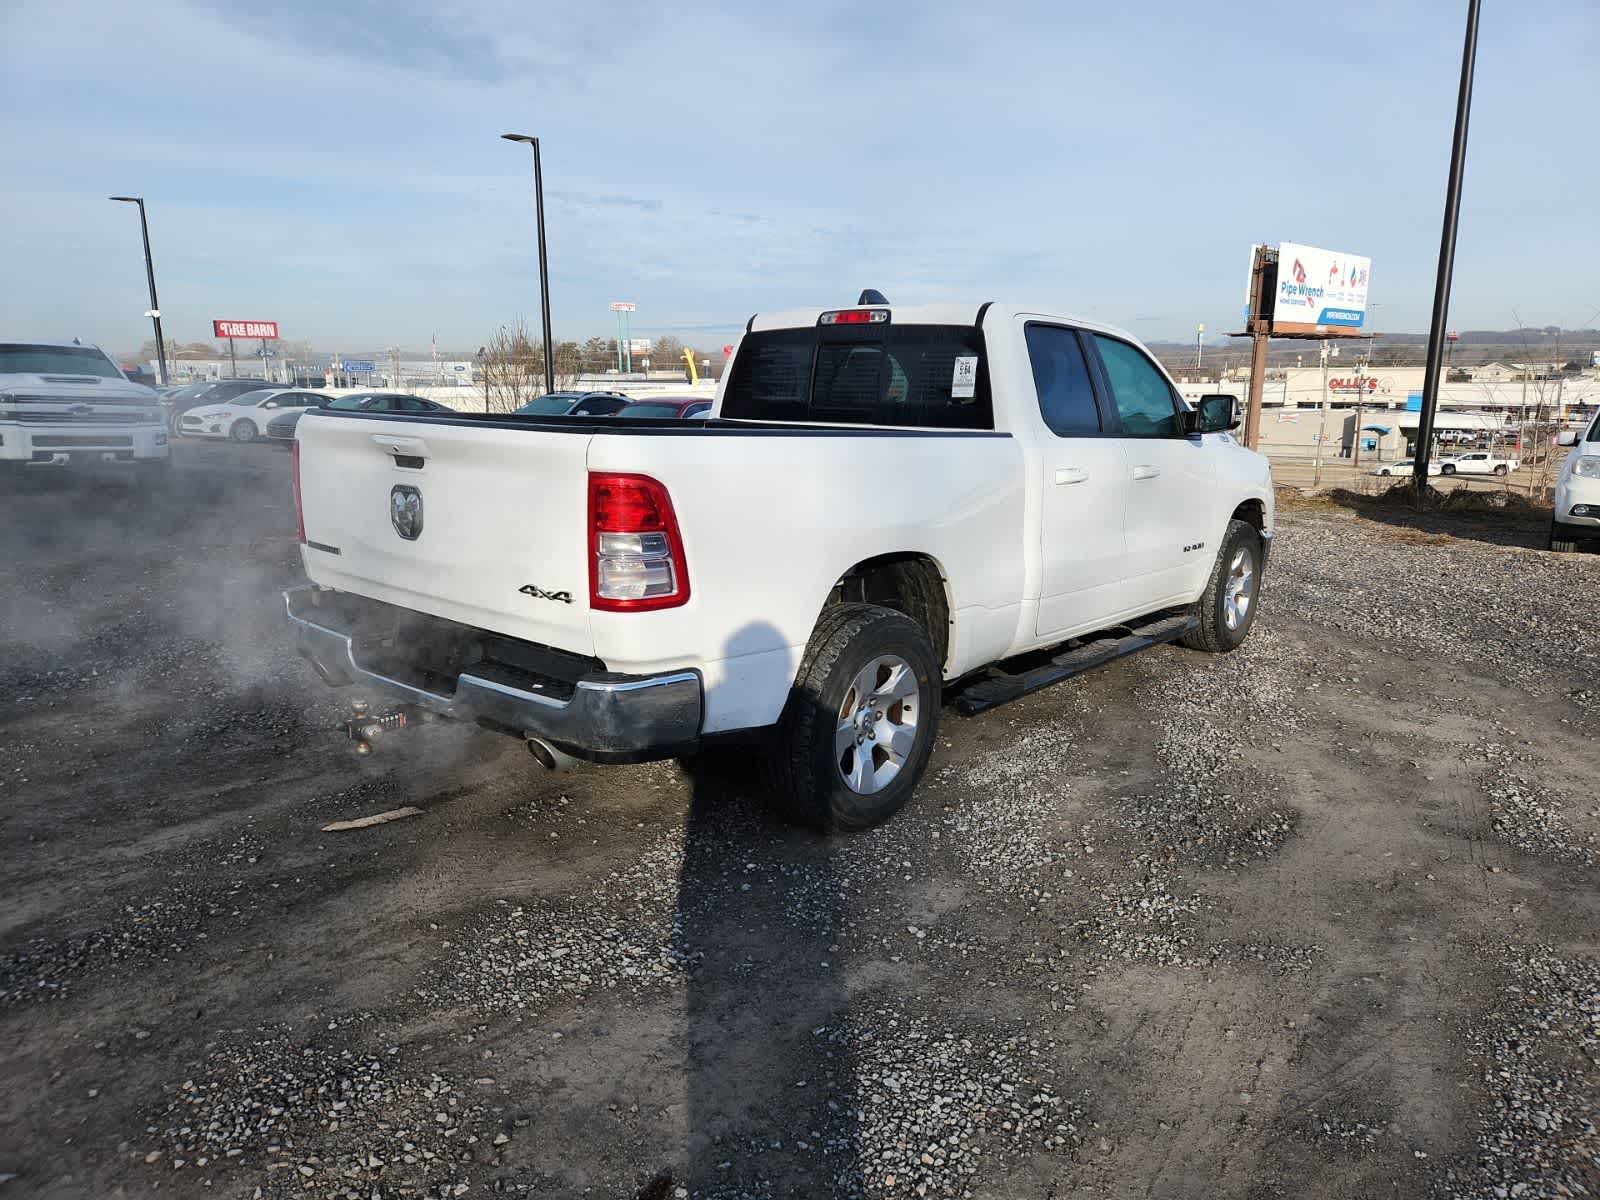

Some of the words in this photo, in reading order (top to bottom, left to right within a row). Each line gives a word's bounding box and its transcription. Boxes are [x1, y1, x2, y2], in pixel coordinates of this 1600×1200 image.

[1281, 281, 1297, 296] Pipe
[1298, 284, 1324, 297] Wrench
[220, 322, 246, 336] TIRE
[246, 323, 275, 337] BARN
